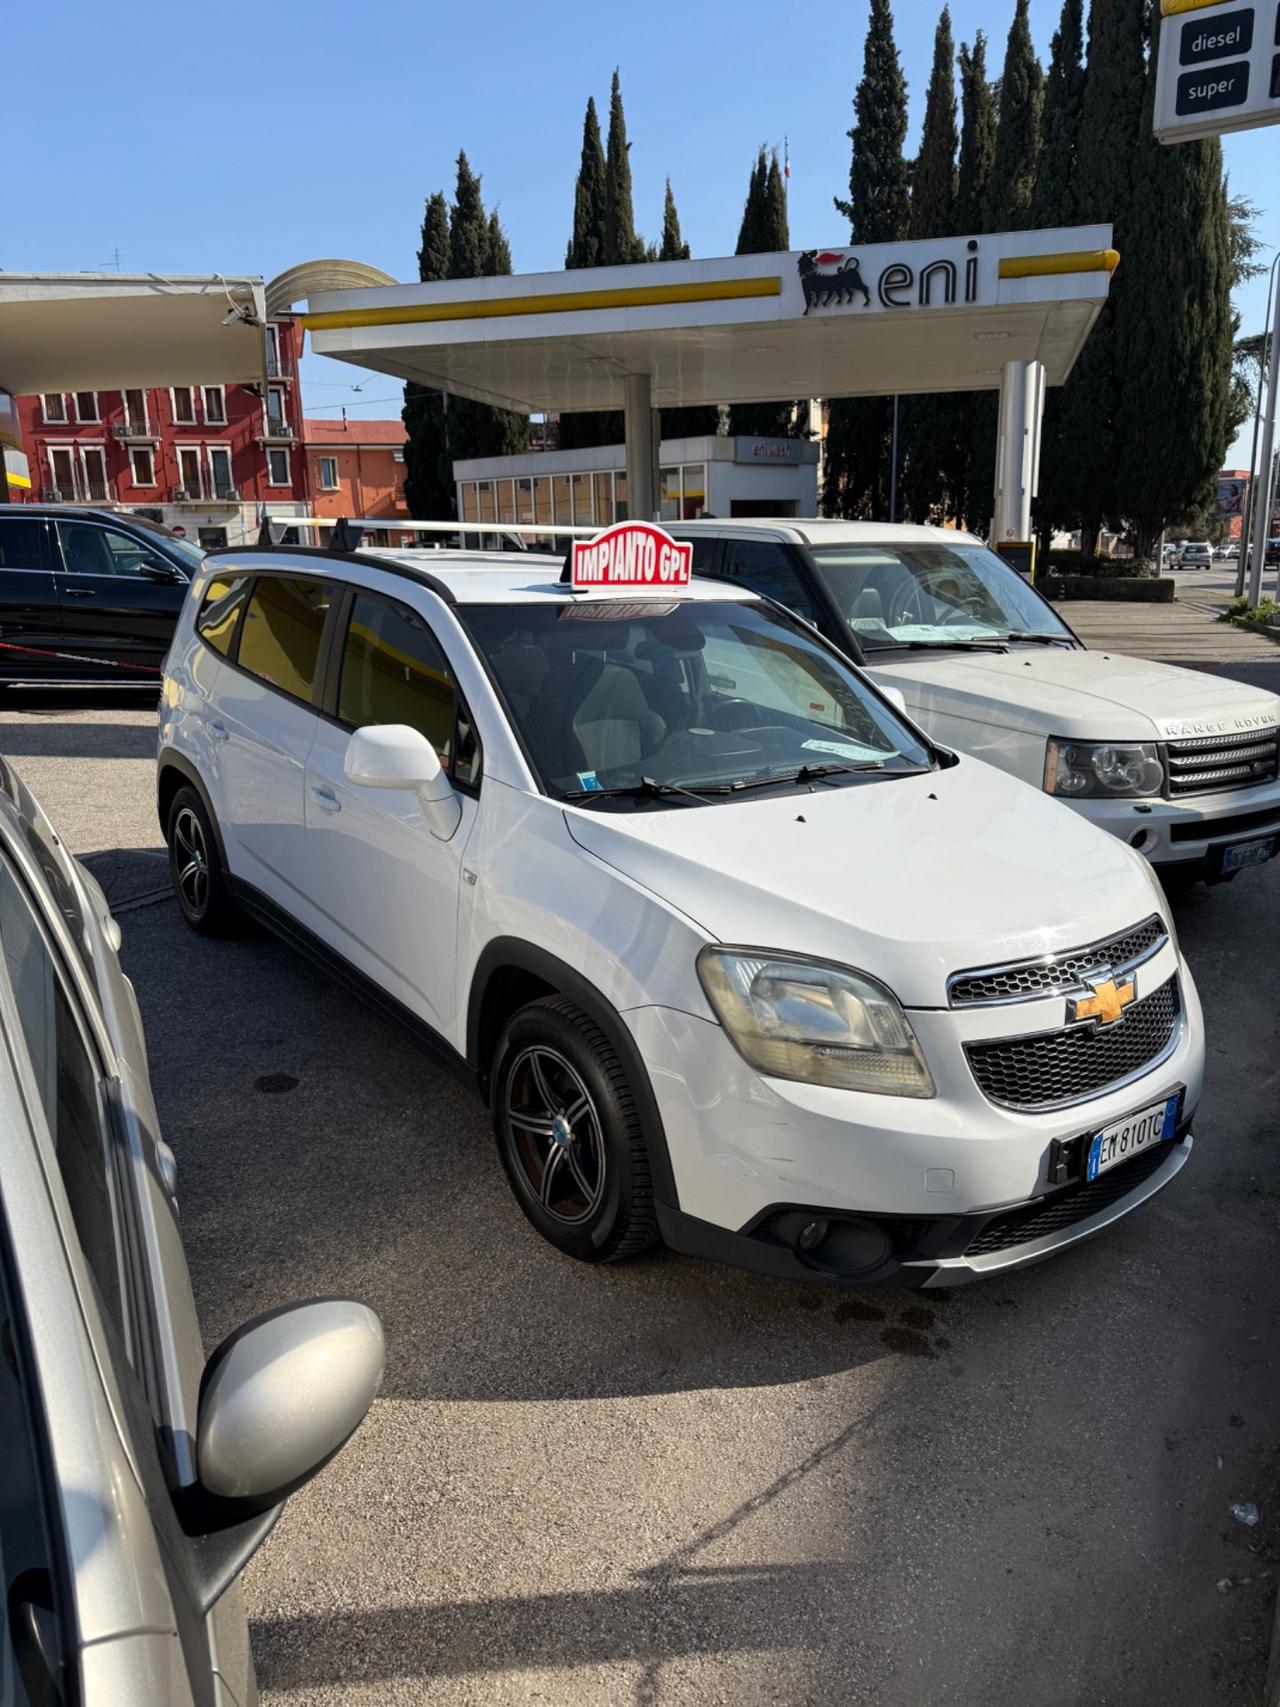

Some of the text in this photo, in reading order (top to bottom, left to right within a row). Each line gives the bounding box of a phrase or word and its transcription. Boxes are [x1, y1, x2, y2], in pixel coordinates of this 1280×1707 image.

[1191, 26, 1241, 52] diesel
[1188, 78, 1235, 100] super
[877, 239, 978, 308] eni
[576, 530, 688, 582] IMPIANTO GPL
[1165, 714, 1276, 736] RANGE ROVER
